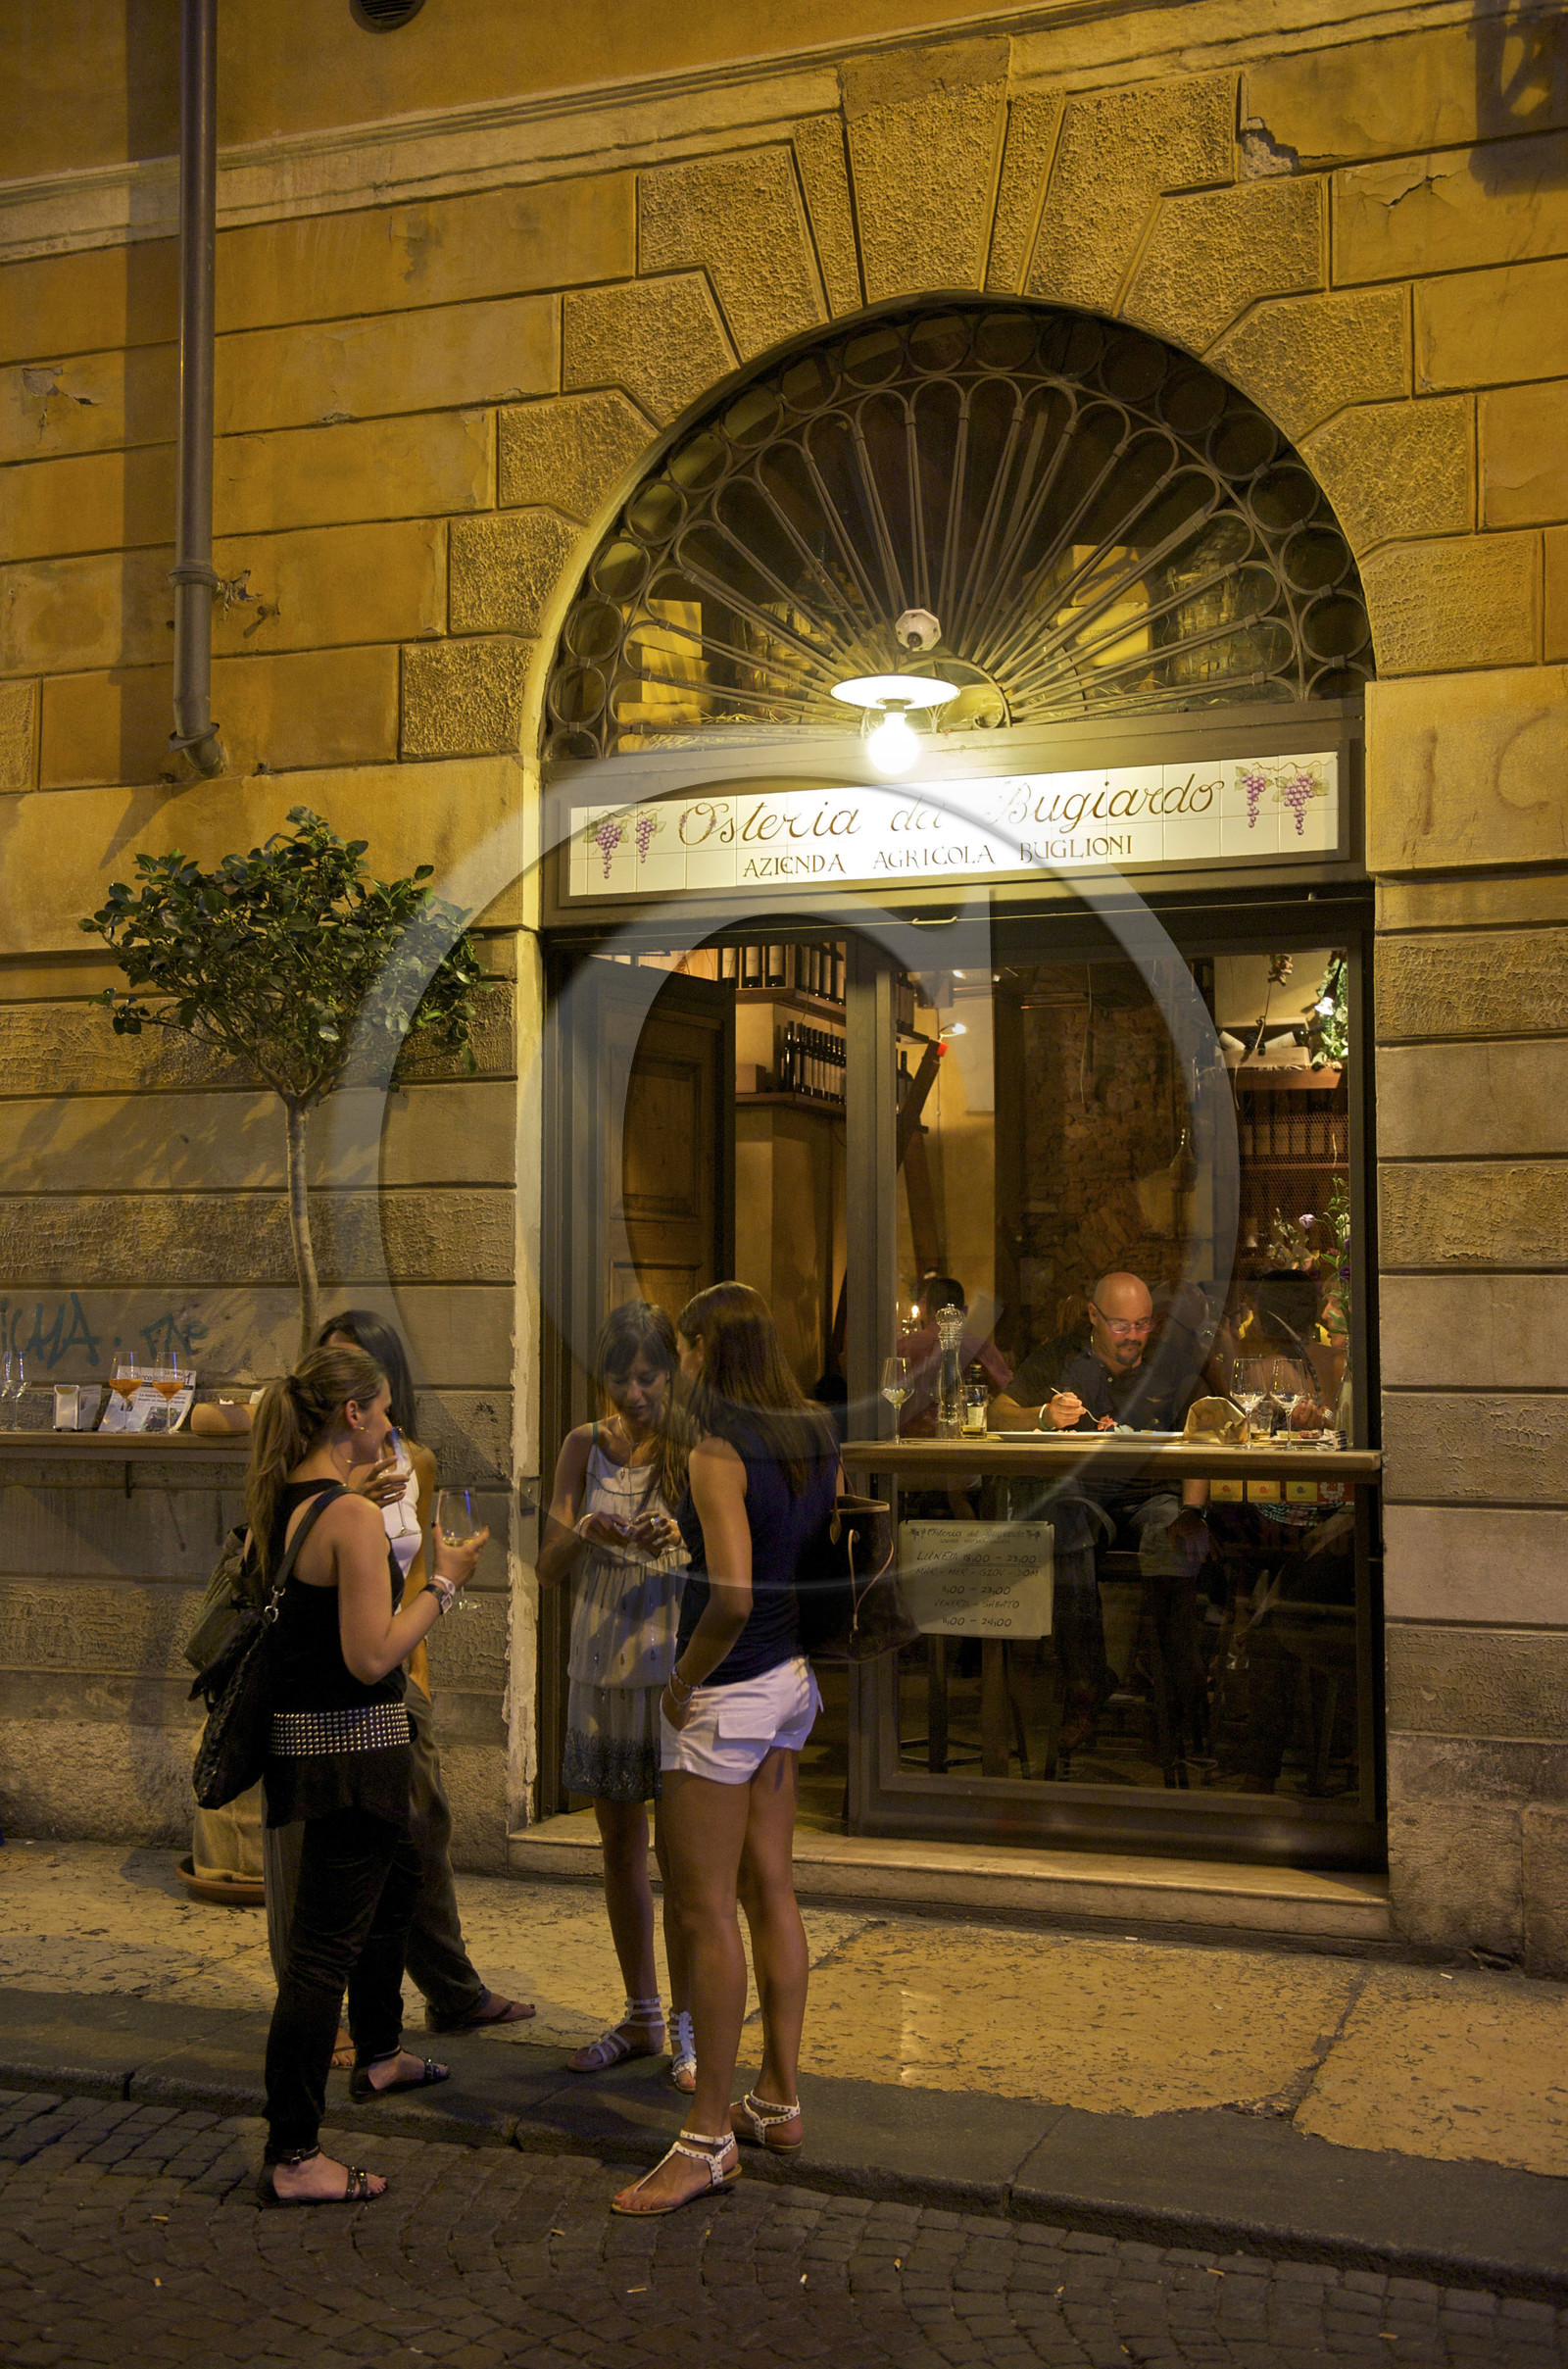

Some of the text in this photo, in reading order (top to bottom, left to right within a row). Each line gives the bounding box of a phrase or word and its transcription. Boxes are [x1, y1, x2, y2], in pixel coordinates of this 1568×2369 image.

[677, 800, 862, 846] Osteria
[983, 772, 1225, 834] Bugiardo
[742, 834, 1133, 879] AZIENDA AGRICOLA BUGLIONI
